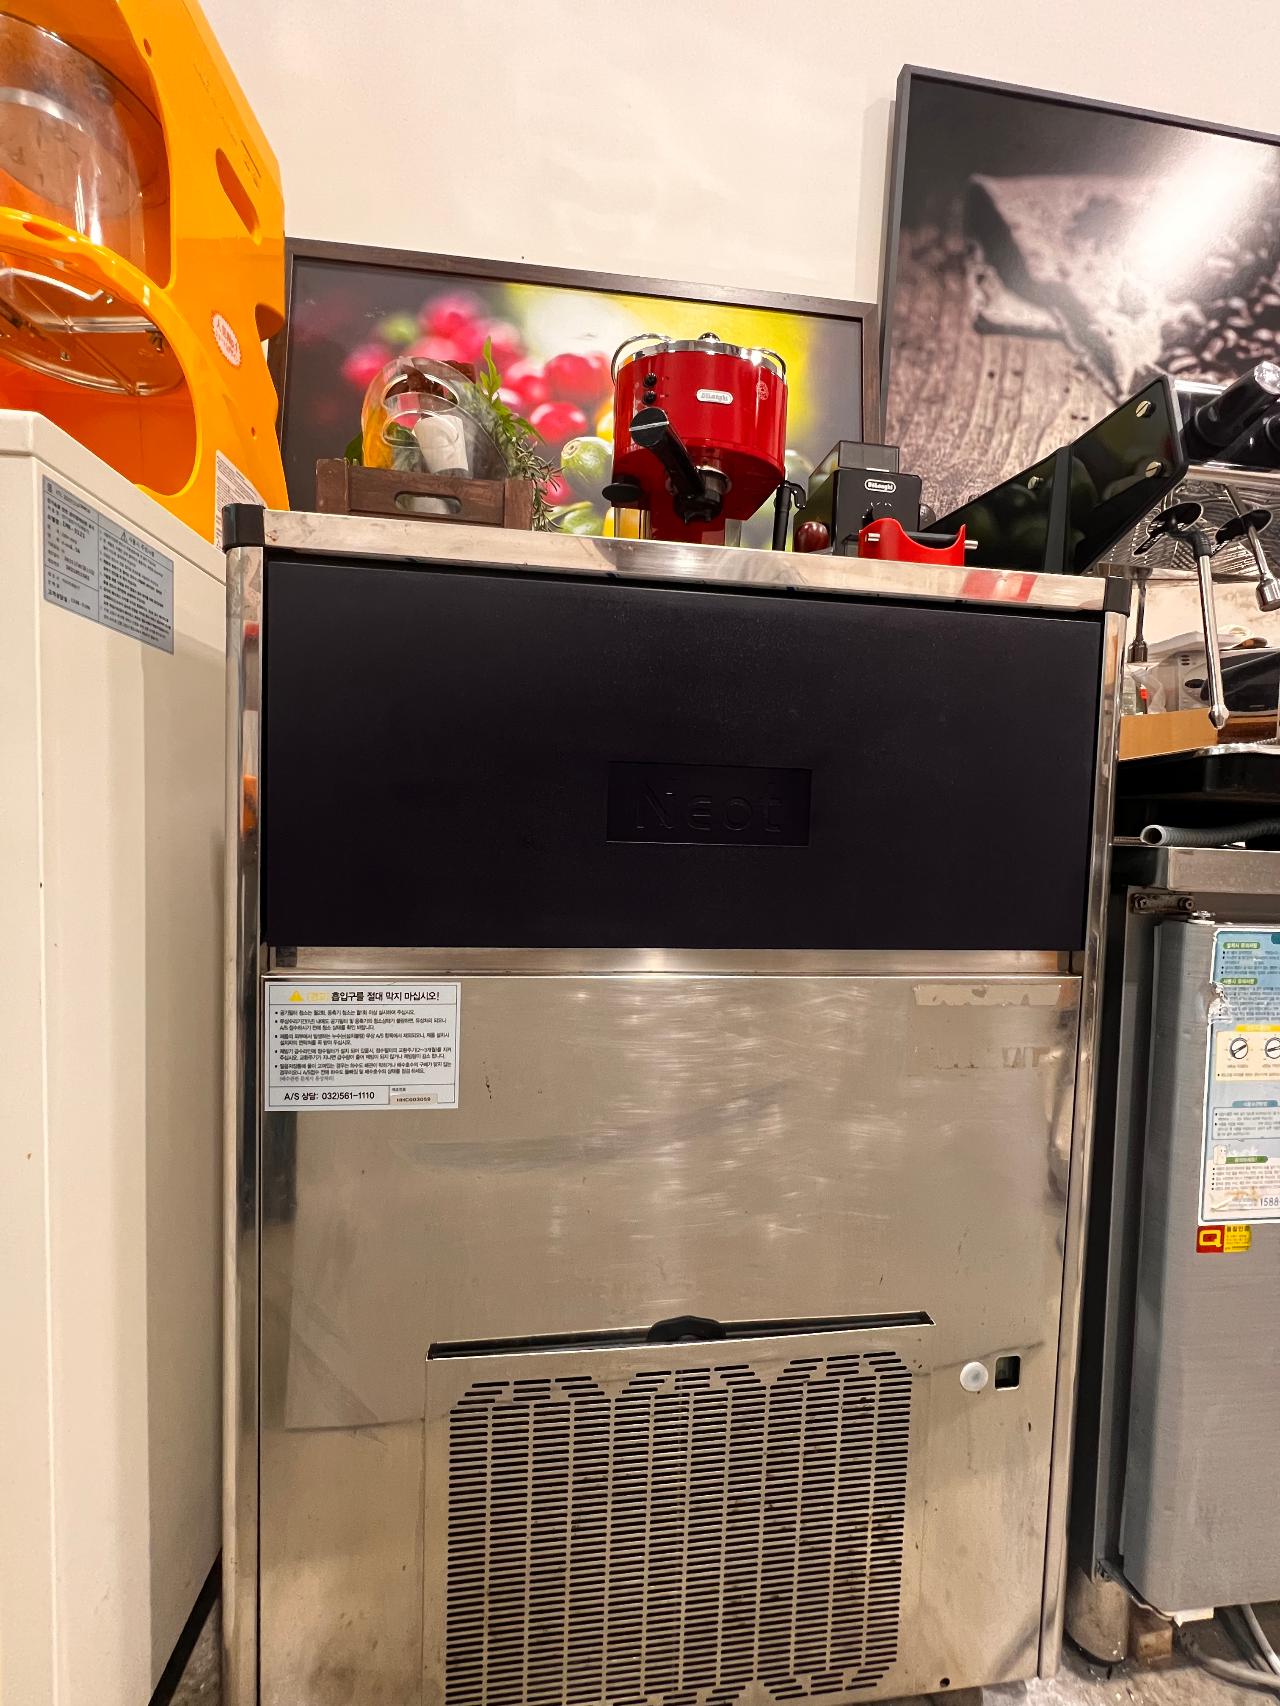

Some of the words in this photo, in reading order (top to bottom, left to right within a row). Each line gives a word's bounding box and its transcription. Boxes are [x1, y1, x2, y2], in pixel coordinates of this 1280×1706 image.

[332, 992, 364, 1002] 흡입구를
[367, 992, 383, 1001] 절대
[386, 992, 401, 1001] 막지
[404, 992, 440, 1001] 마십시오!
[284, 1092, 300, 1101] A/S
[302, 1092, 319, 1101] 상담:
[321, 1091, 375, 1100] 032)561-1110
